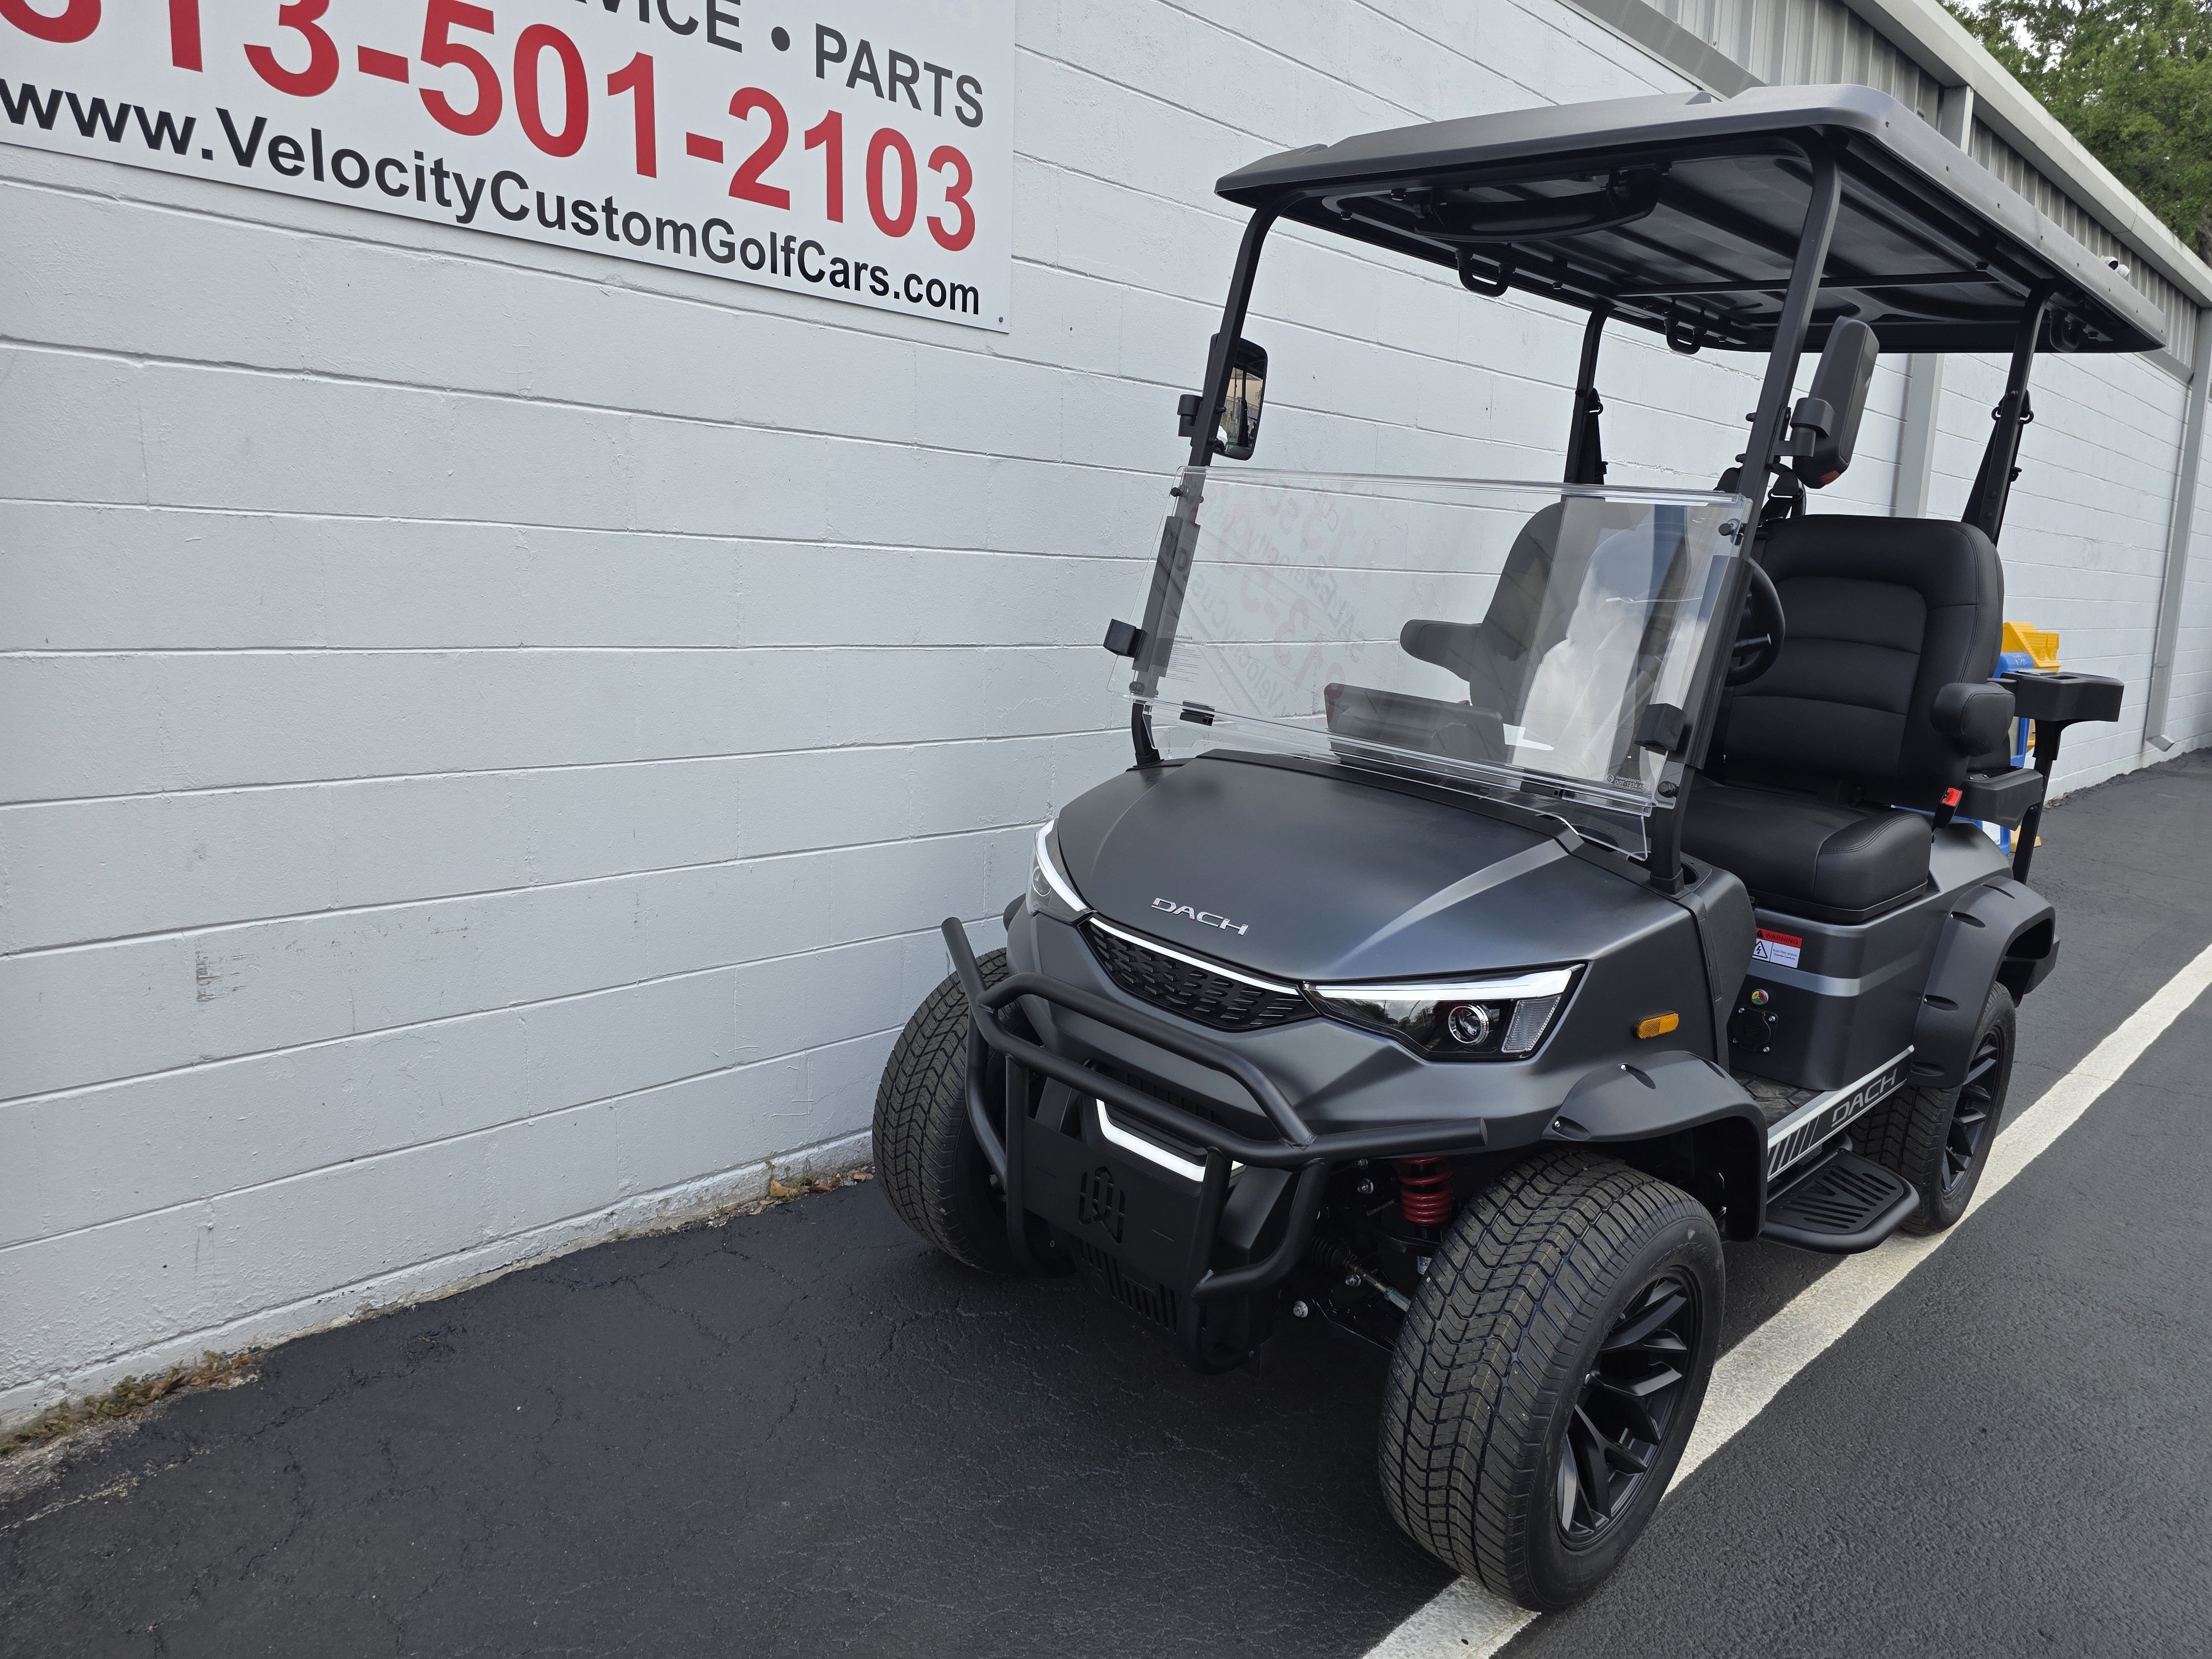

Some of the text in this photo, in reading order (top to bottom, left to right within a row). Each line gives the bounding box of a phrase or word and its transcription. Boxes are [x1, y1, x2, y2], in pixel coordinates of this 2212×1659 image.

[816, 23, 983, 128] PARTS
[0, 0, 975, 252] 3-501-2103
[0, 79, 979, 315] www.VelocityCustomGolfCars.com
[1615, 780, 1637, 788] DOT-1234
[1151, 898, 1249, 936] DACH
[1766, 932, 1798, 945] WARNING
[1831, 1068, 1897, 1128] DACH
